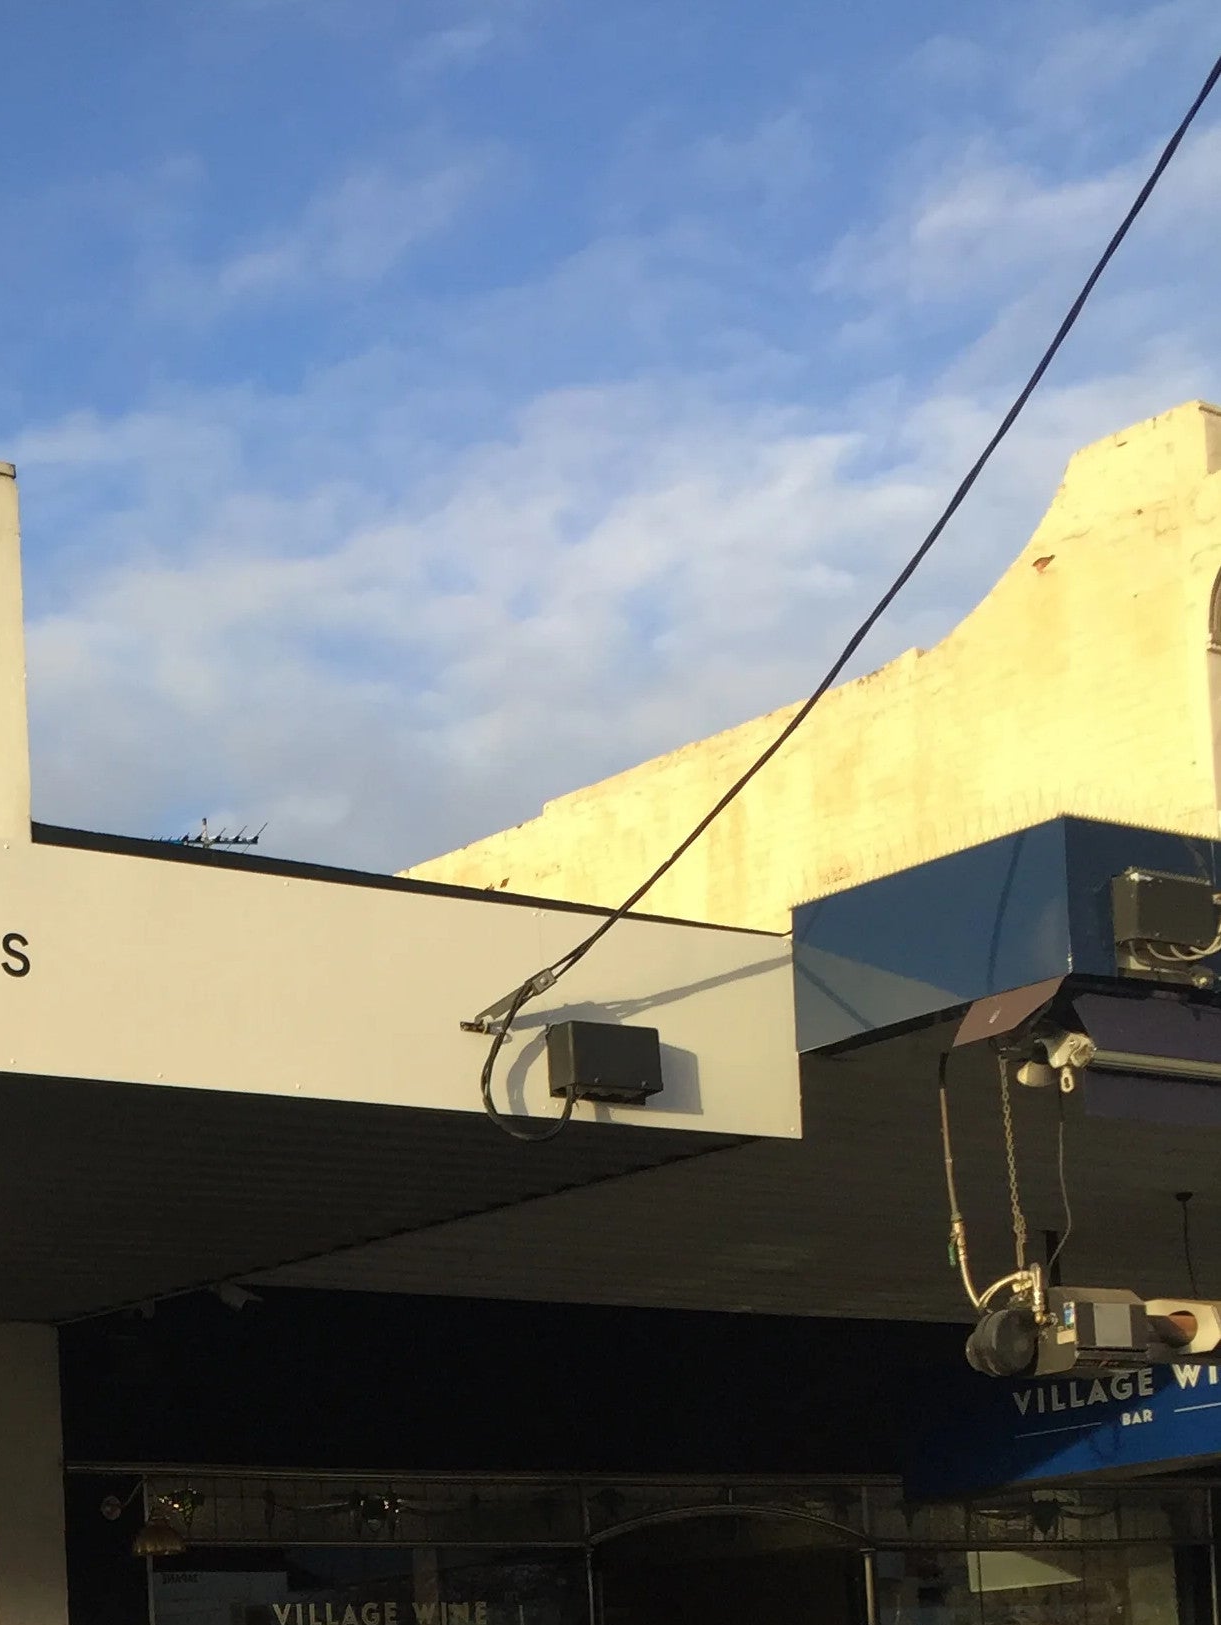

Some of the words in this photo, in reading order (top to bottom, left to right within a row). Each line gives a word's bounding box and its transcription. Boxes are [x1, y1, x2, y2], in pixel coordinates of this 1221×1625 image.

[1012, 1367, 1155, 1416] VILLAGE
[1121, 1408, 1153, 1426] BAR
[412, 1601, 487, 1625] WINE
